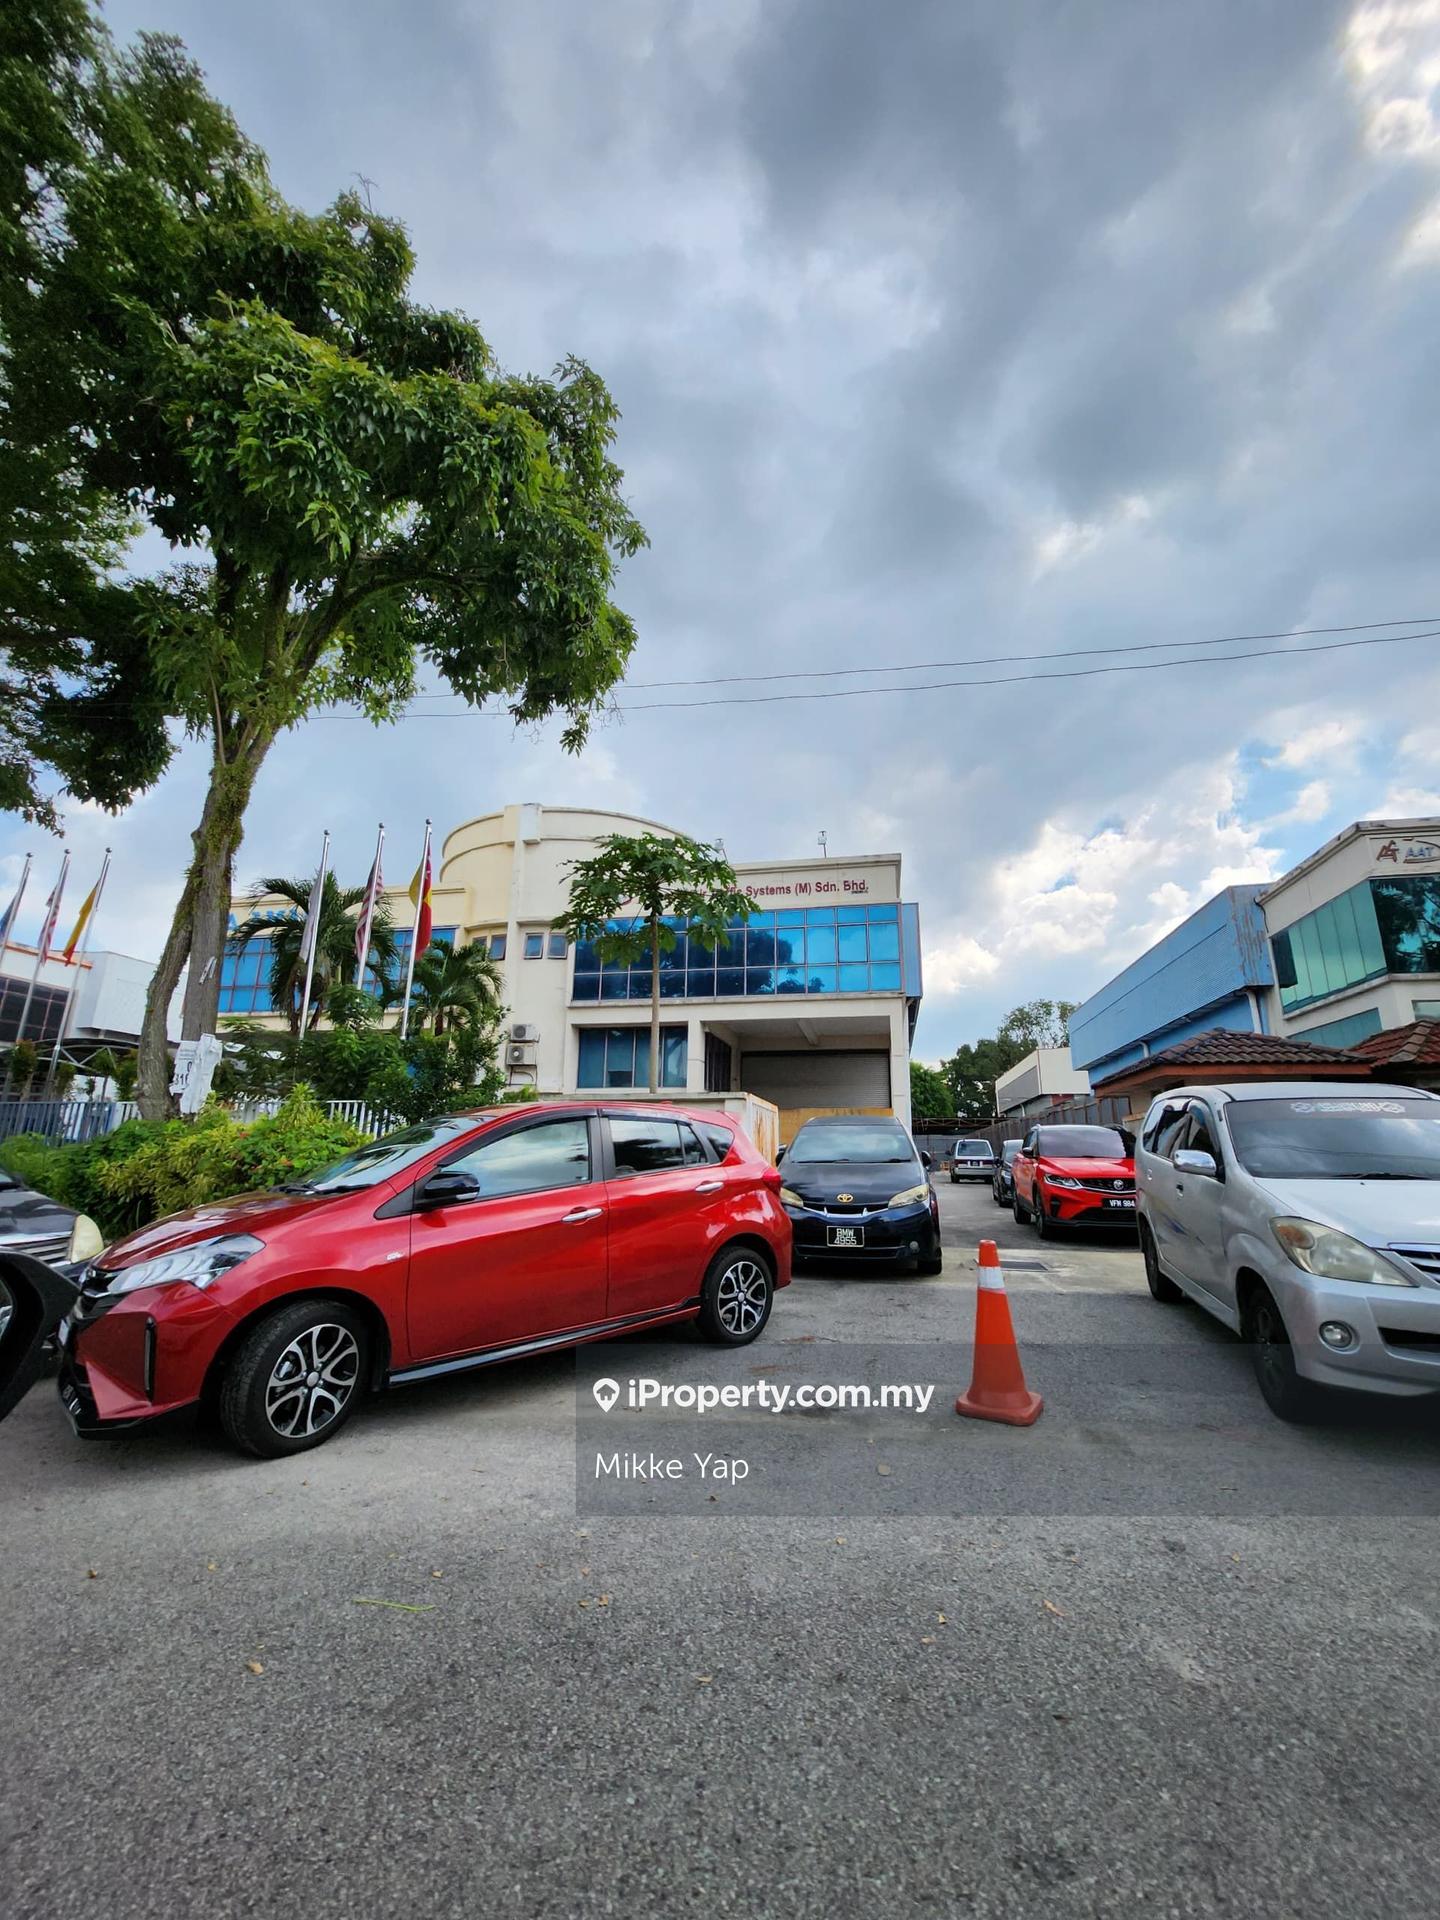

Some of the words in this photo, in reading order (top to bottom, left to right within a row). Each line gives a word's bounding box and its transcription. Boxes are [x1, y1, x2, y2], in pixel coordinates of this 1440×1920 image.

[745, 885, 792, 899] Systems
[795, 882, 812, 896] (M)
[815, 881, 840, 893] Sdn.
[843, 879, 869, 892] Bhd.
[836, 1228, 855, 1238] BMW
[833, 1236, 857, 1245] 4955
